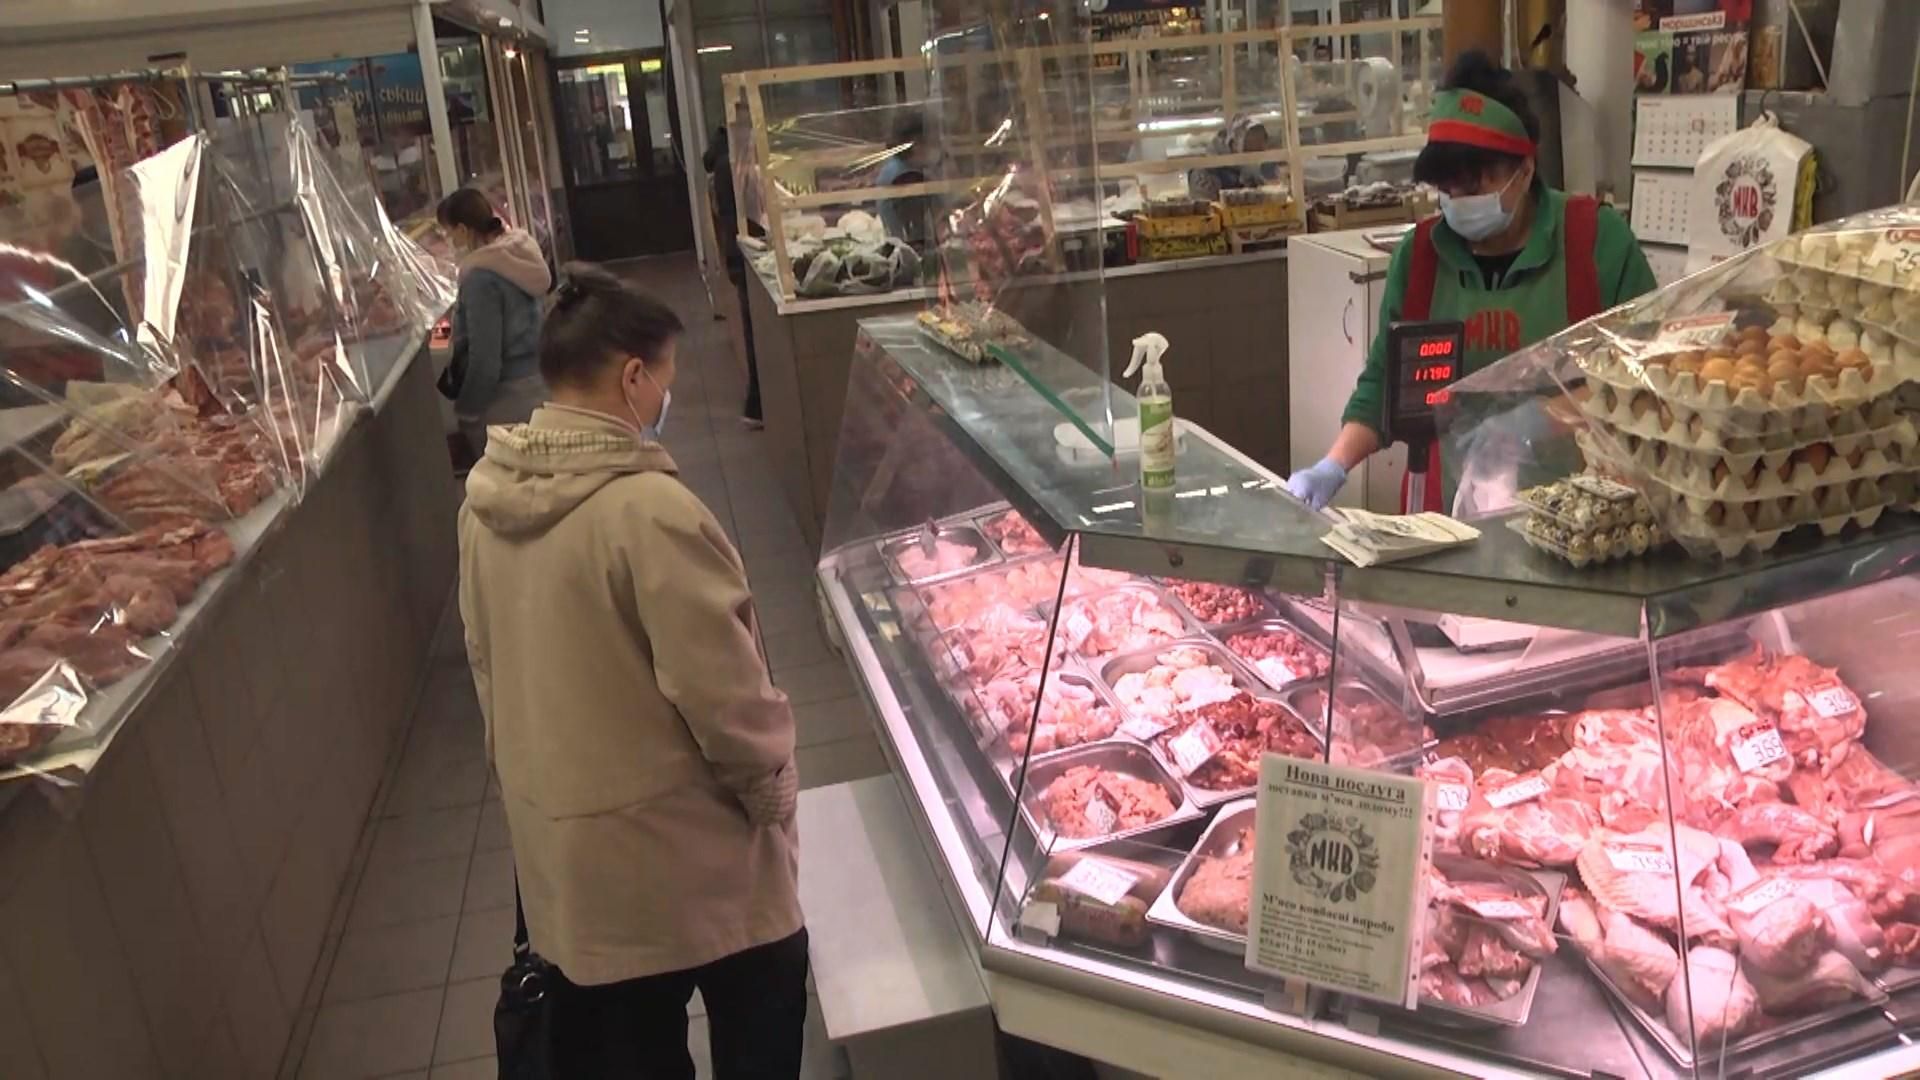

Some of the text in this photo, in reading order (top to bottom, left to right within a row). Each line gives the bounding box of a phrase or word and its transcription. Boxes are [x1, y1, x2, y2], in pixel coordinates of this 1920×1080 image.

[1464, 308, 1521, 351] МКВ
[1286, 764, 1406, 800] Нова послуга
[1311, 839, 1355, 876] МКВ
